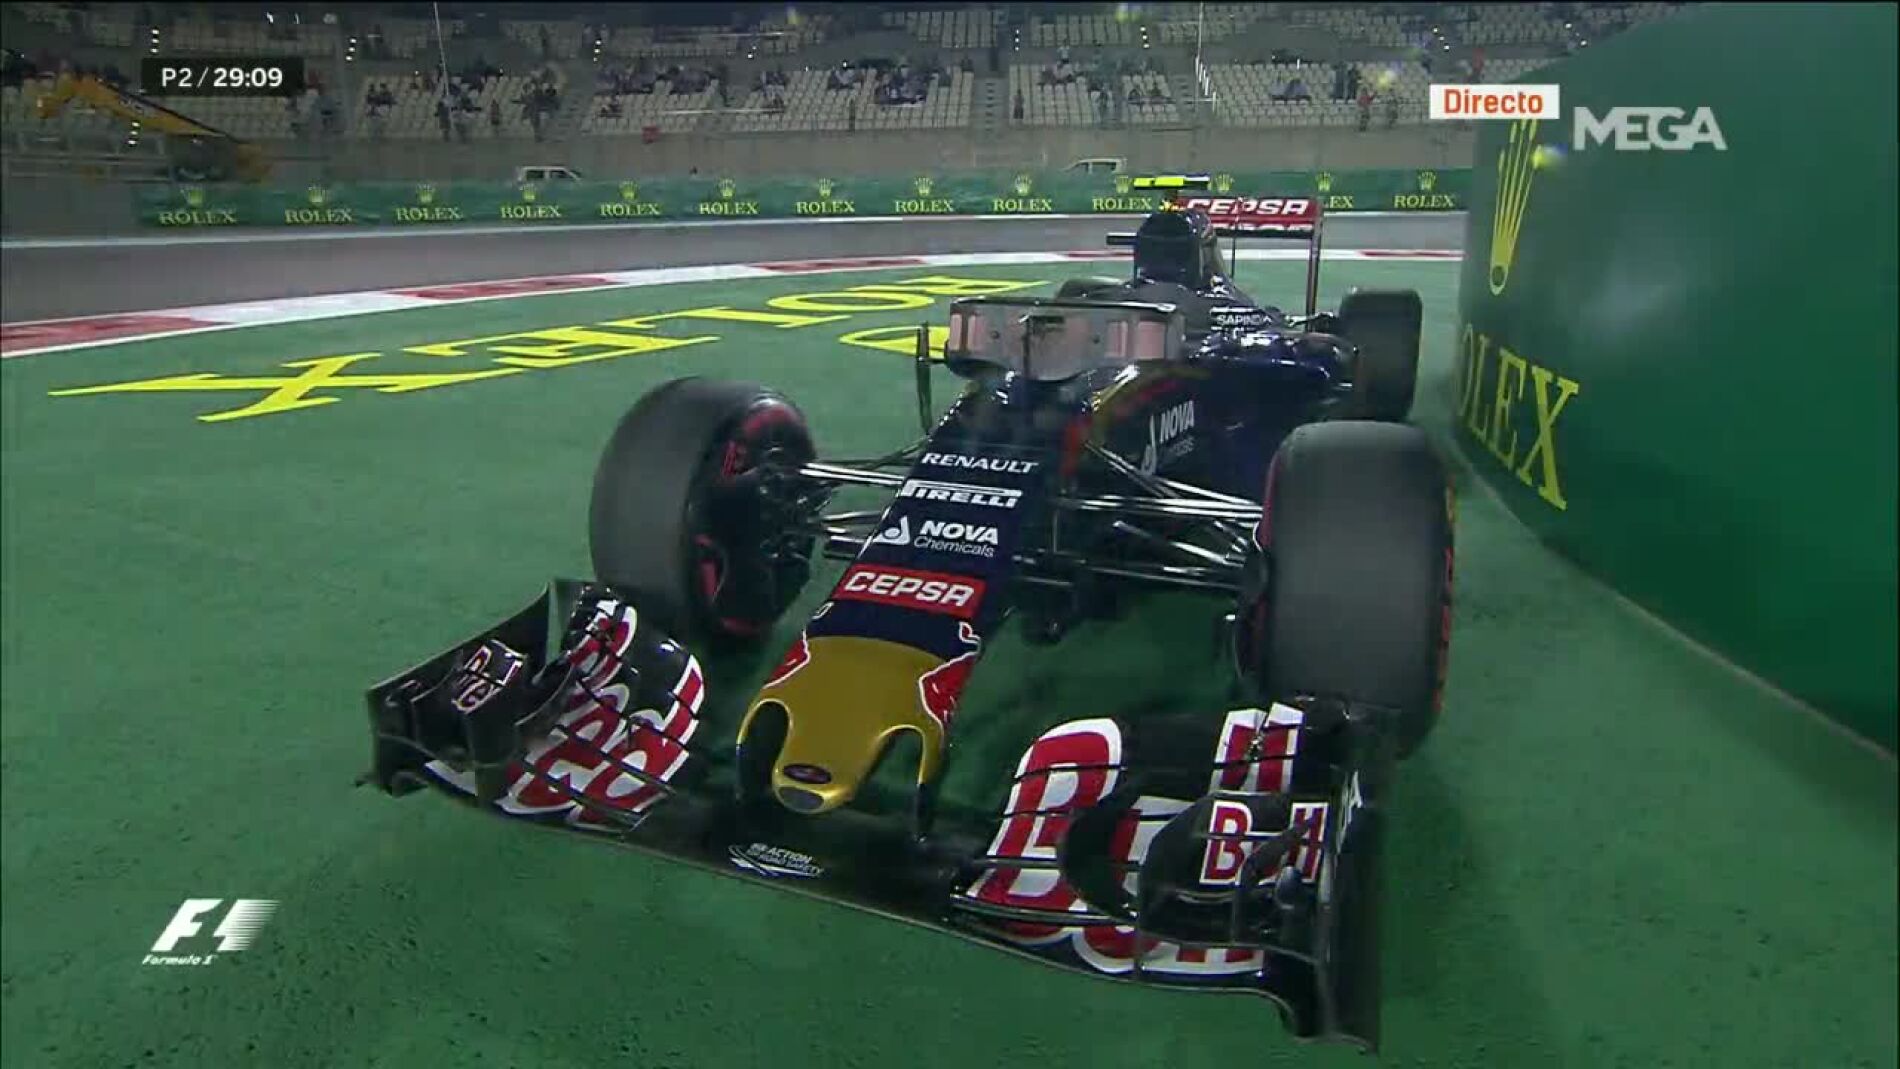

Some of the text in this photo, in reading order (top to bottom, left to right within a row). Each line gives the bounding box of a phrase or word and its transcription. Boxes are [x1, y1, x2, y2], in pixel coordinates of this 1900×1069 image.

[600, 202, 662, 217] ROLEX
[699, 201, 759, 216] ROLEX
[795, 200, 856, 214] ROLEX
[895, 199, 955, 213] ROLEX
[992, 198, 1053, 212] ROLEX
[1092, 197, 1153, 212] ROLEX
[1393, 194, 1455, 209] ROLEX
[159, 207, 239, 226] ROLEX
[283, 208, 355, 225] ROLEX
[395, 206, 464, 222] ROLEX
[500, 204, 563, 220] ROLEX
[1159, 400, 1195, 445] NOVA
[1456, 323, 1579, 511] OLEX
[920, 452, 1040, 474] RENAULT
[899, 479, 1024, 509] PIRELLI
[918, 519, 999, 546] NOVA
[913, 535, 996, 558] Chemicals
[844, 571, 976, 607] CEPSA
